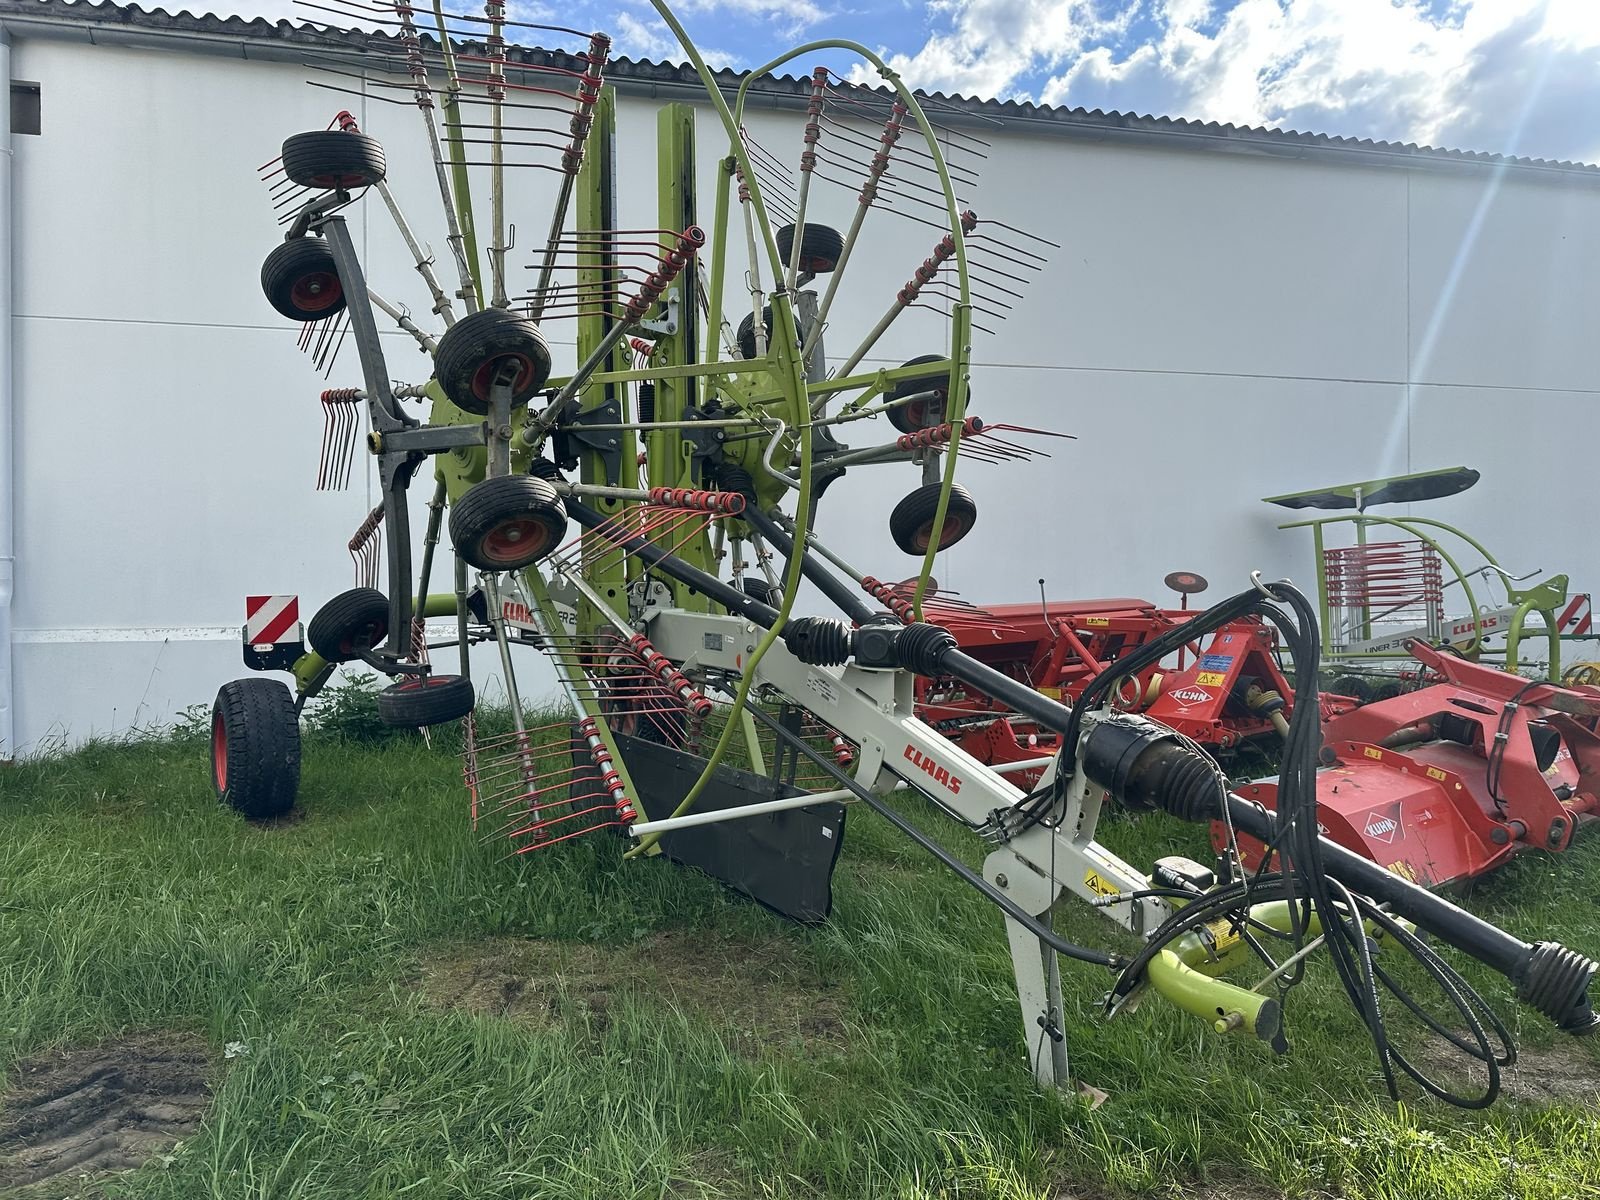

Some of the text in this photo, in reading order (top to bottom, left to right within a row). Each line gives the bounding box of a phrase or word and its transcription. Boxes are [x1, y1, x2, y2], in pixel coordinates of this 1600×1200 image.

[1174, 690, 1207, 701] KUHN
[904, 744, 962, 795] CLAAS
[1367, 818, 1395, 837] KUHN
